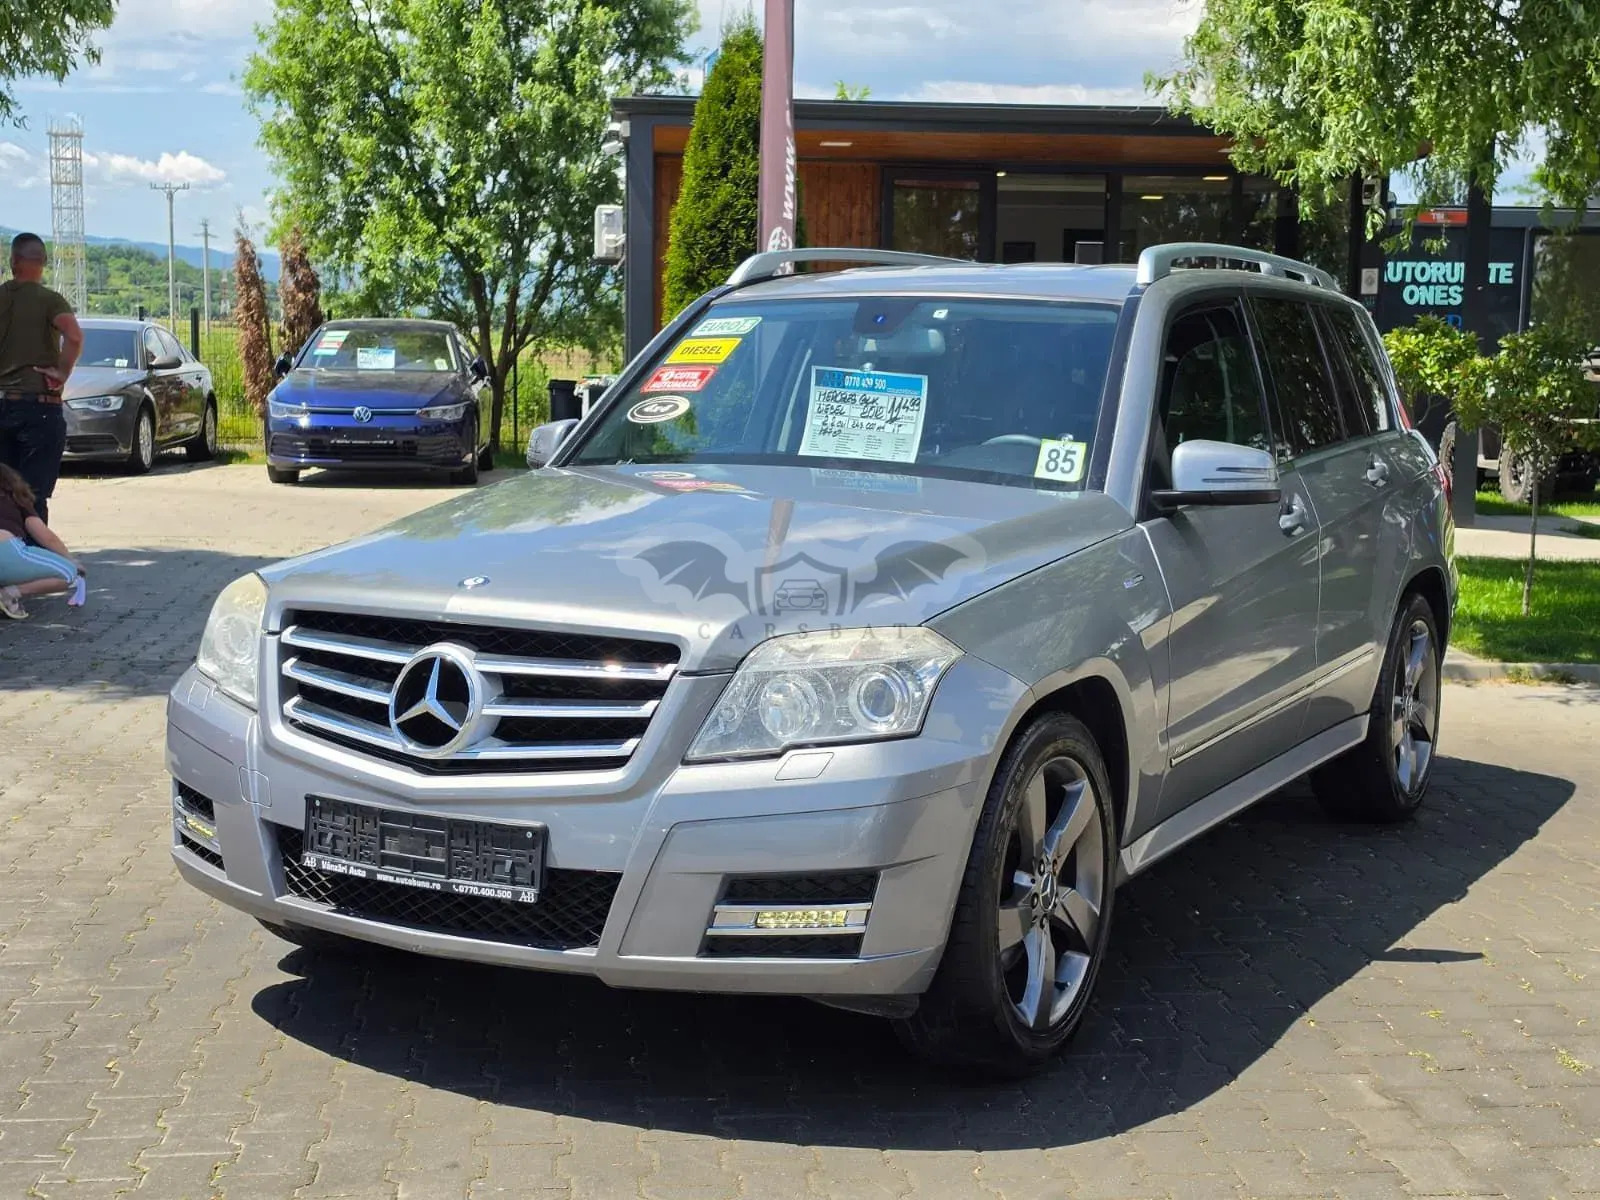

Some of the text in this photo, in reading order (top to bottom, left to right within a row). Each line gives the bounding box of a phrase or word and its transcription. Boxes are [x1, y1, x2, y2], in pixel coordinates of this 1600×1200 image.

[698, 319, 741, 333] EURO
[679, 345, 722, 356] DIESEL
[1045, 448, 1077, 475] 85
[348, 866, 367, 878] Auto
[458, 885, 512, 900] 0770.400.500
